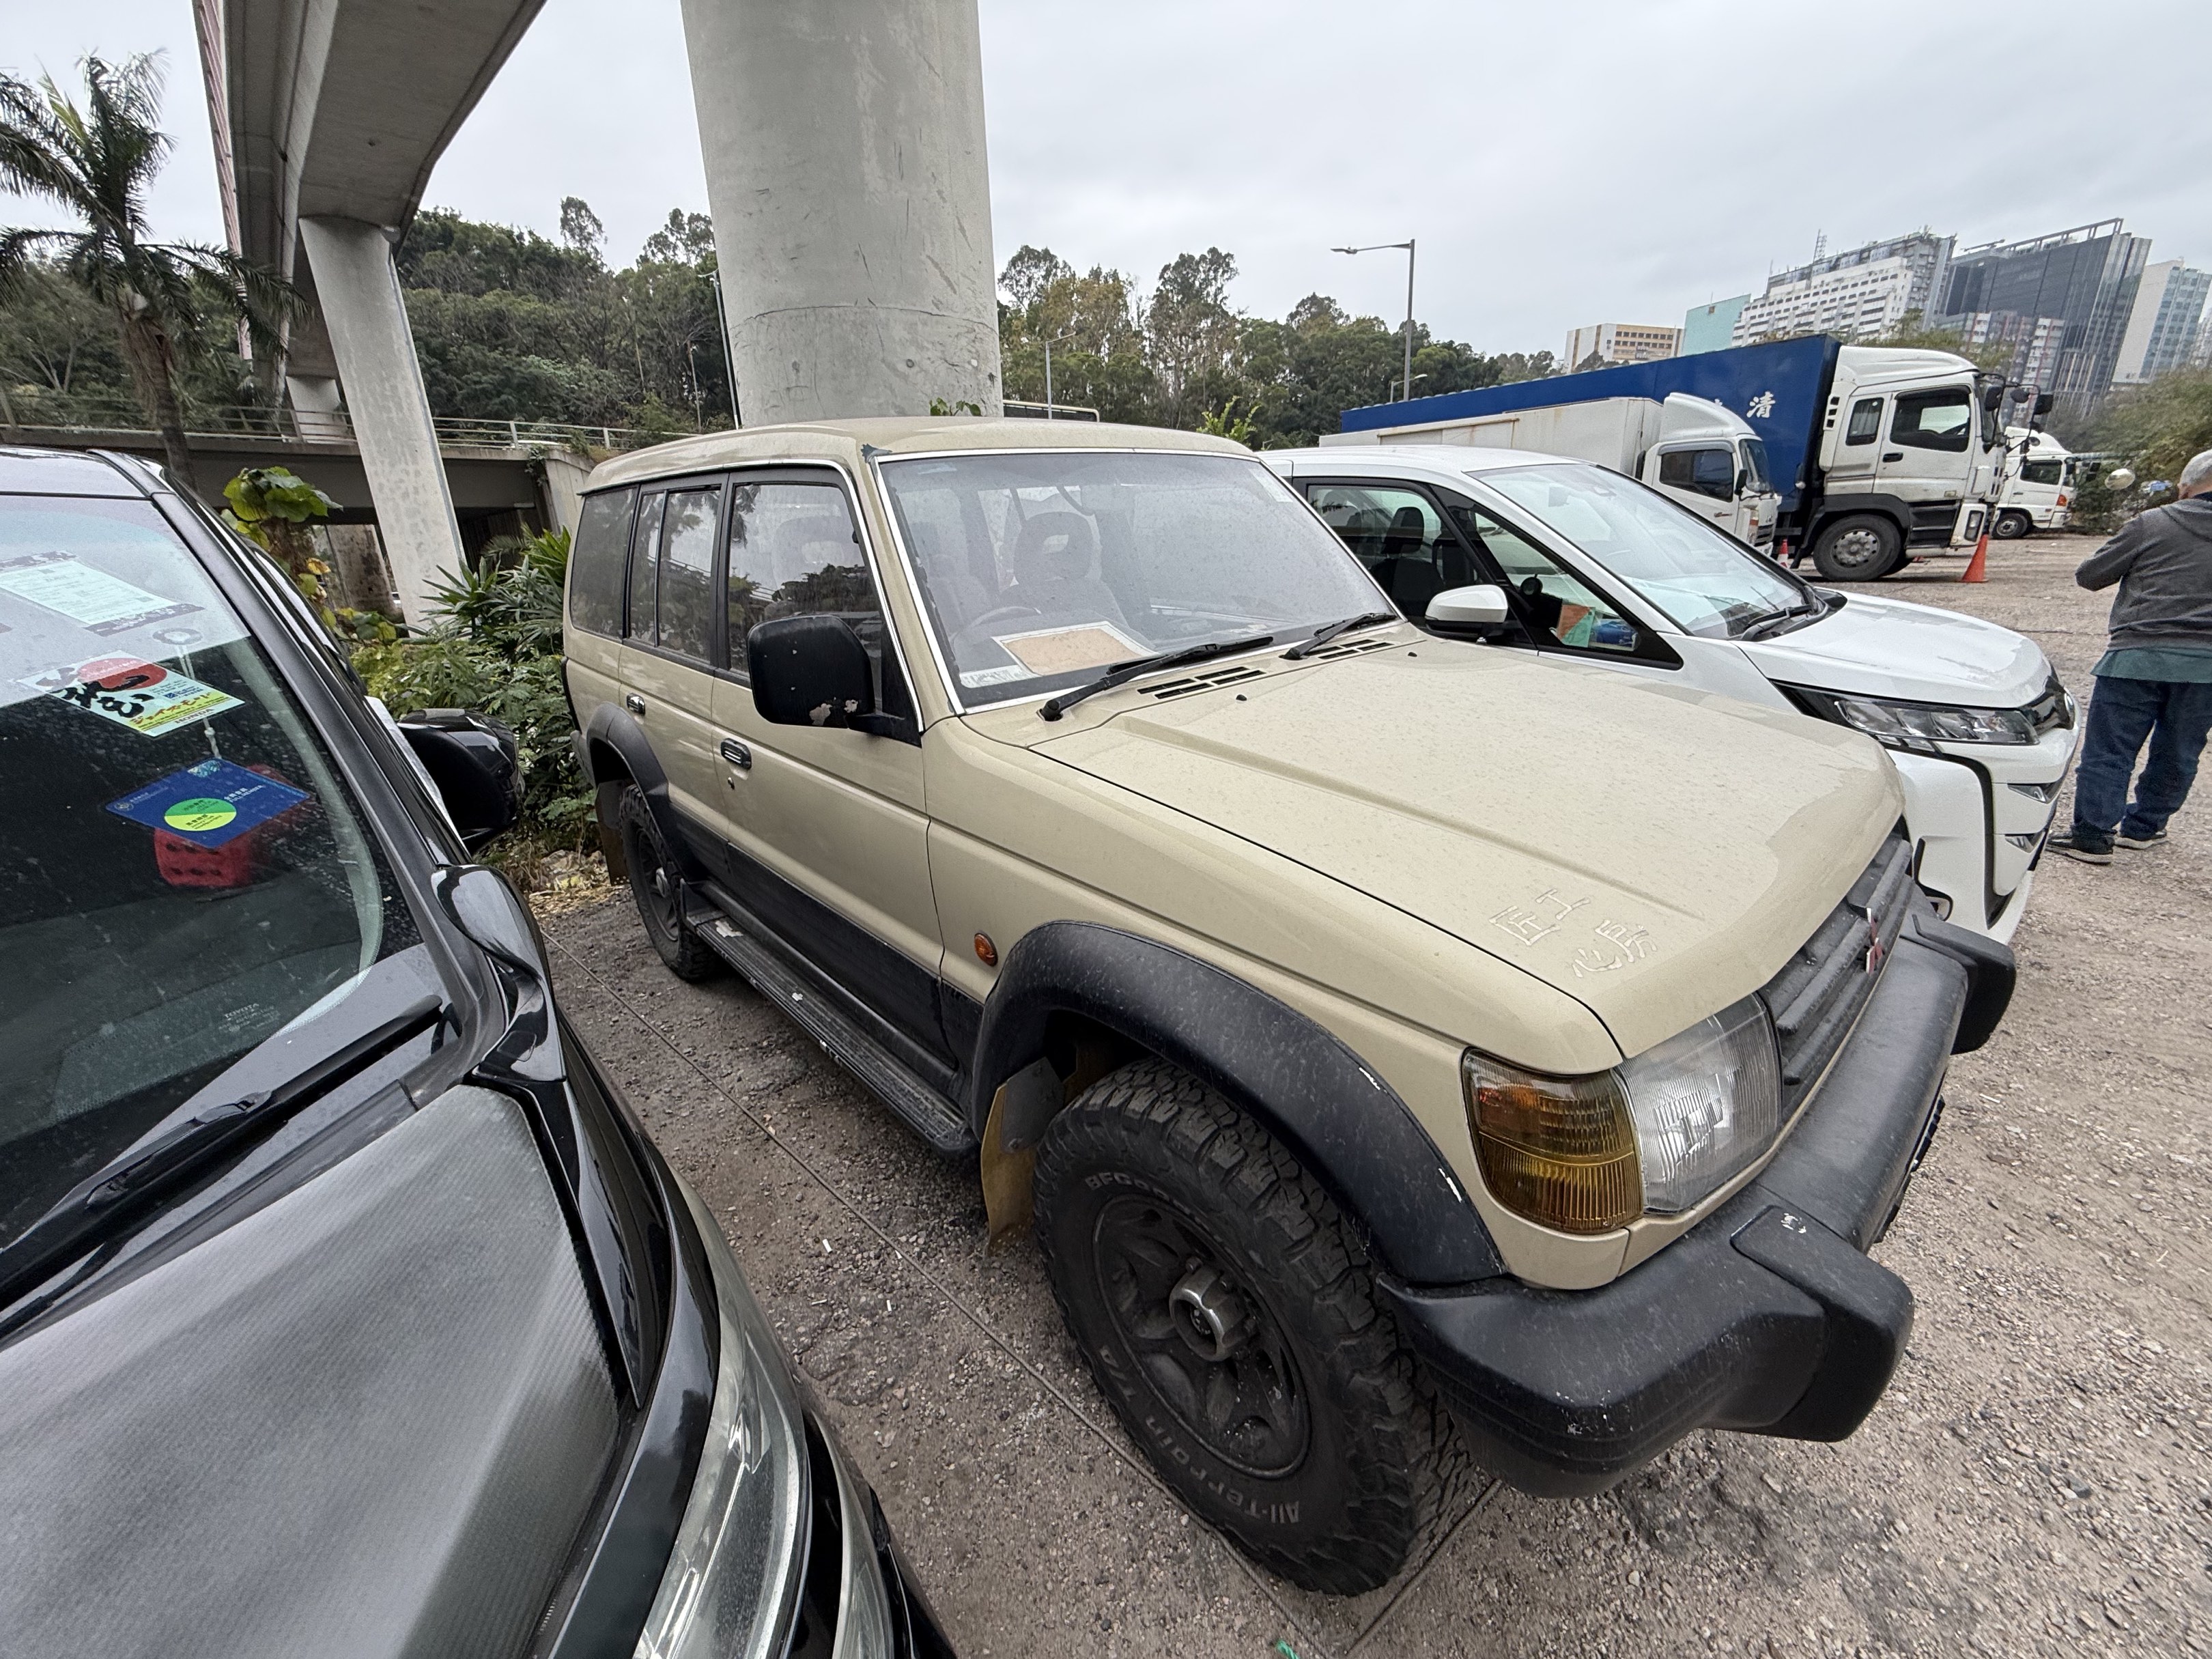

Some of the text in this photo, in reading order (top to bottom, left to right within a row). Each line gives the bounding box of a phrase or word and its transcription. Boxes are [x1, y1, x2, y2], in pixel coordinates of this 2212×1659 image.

[1746, 391, 1776, 418] 清
[174, 707, 215, 725] HONDA
[225, 1003, 259, 1019] TOYOTA
